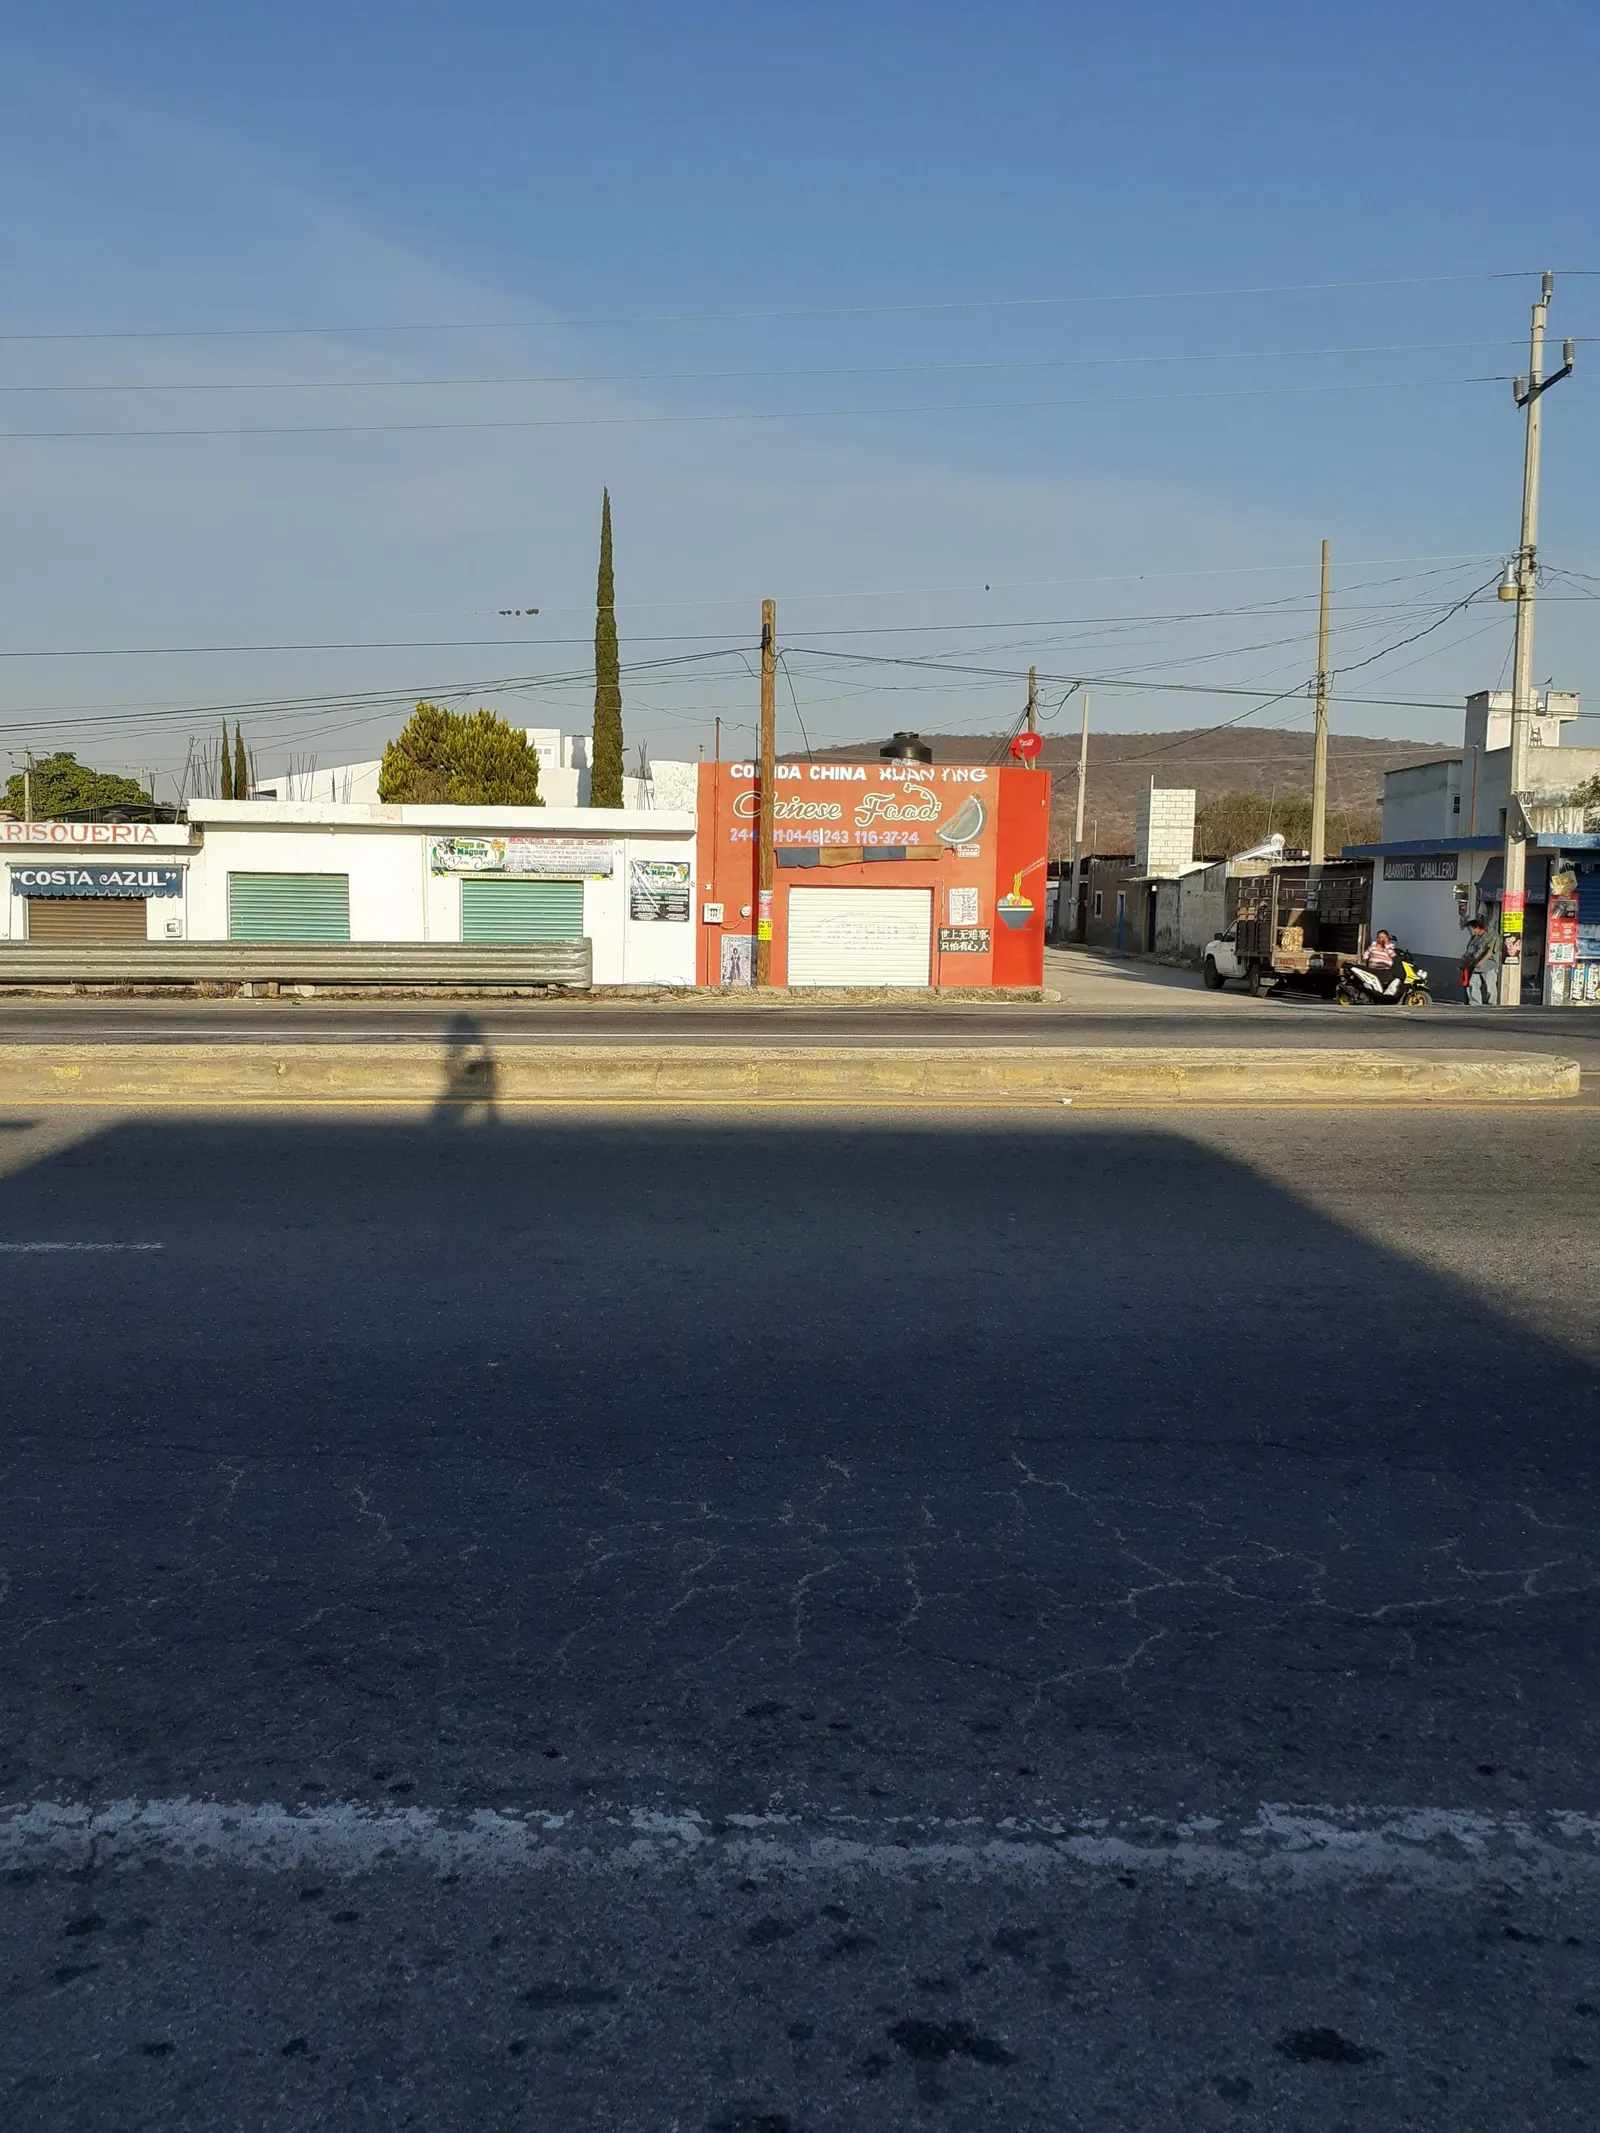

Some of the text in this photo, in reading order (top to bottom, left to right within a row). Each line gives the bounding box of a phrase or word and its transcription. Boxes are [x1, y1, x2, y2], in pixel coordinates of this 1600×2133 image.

[730, 764, 802, 780] COIDA
[810, 765, 867, 781] CHINA
[941, 768, 989, 783] YING
[733, 782, 942, 827] Chinese Food
[0, 824, 159, 842] RISQUERIA
[457, 848, 488, 857] Maguey
[1384, 863, 1416, 879] ABARROTES
[940, 940, 989, 952] 只怕有心人
